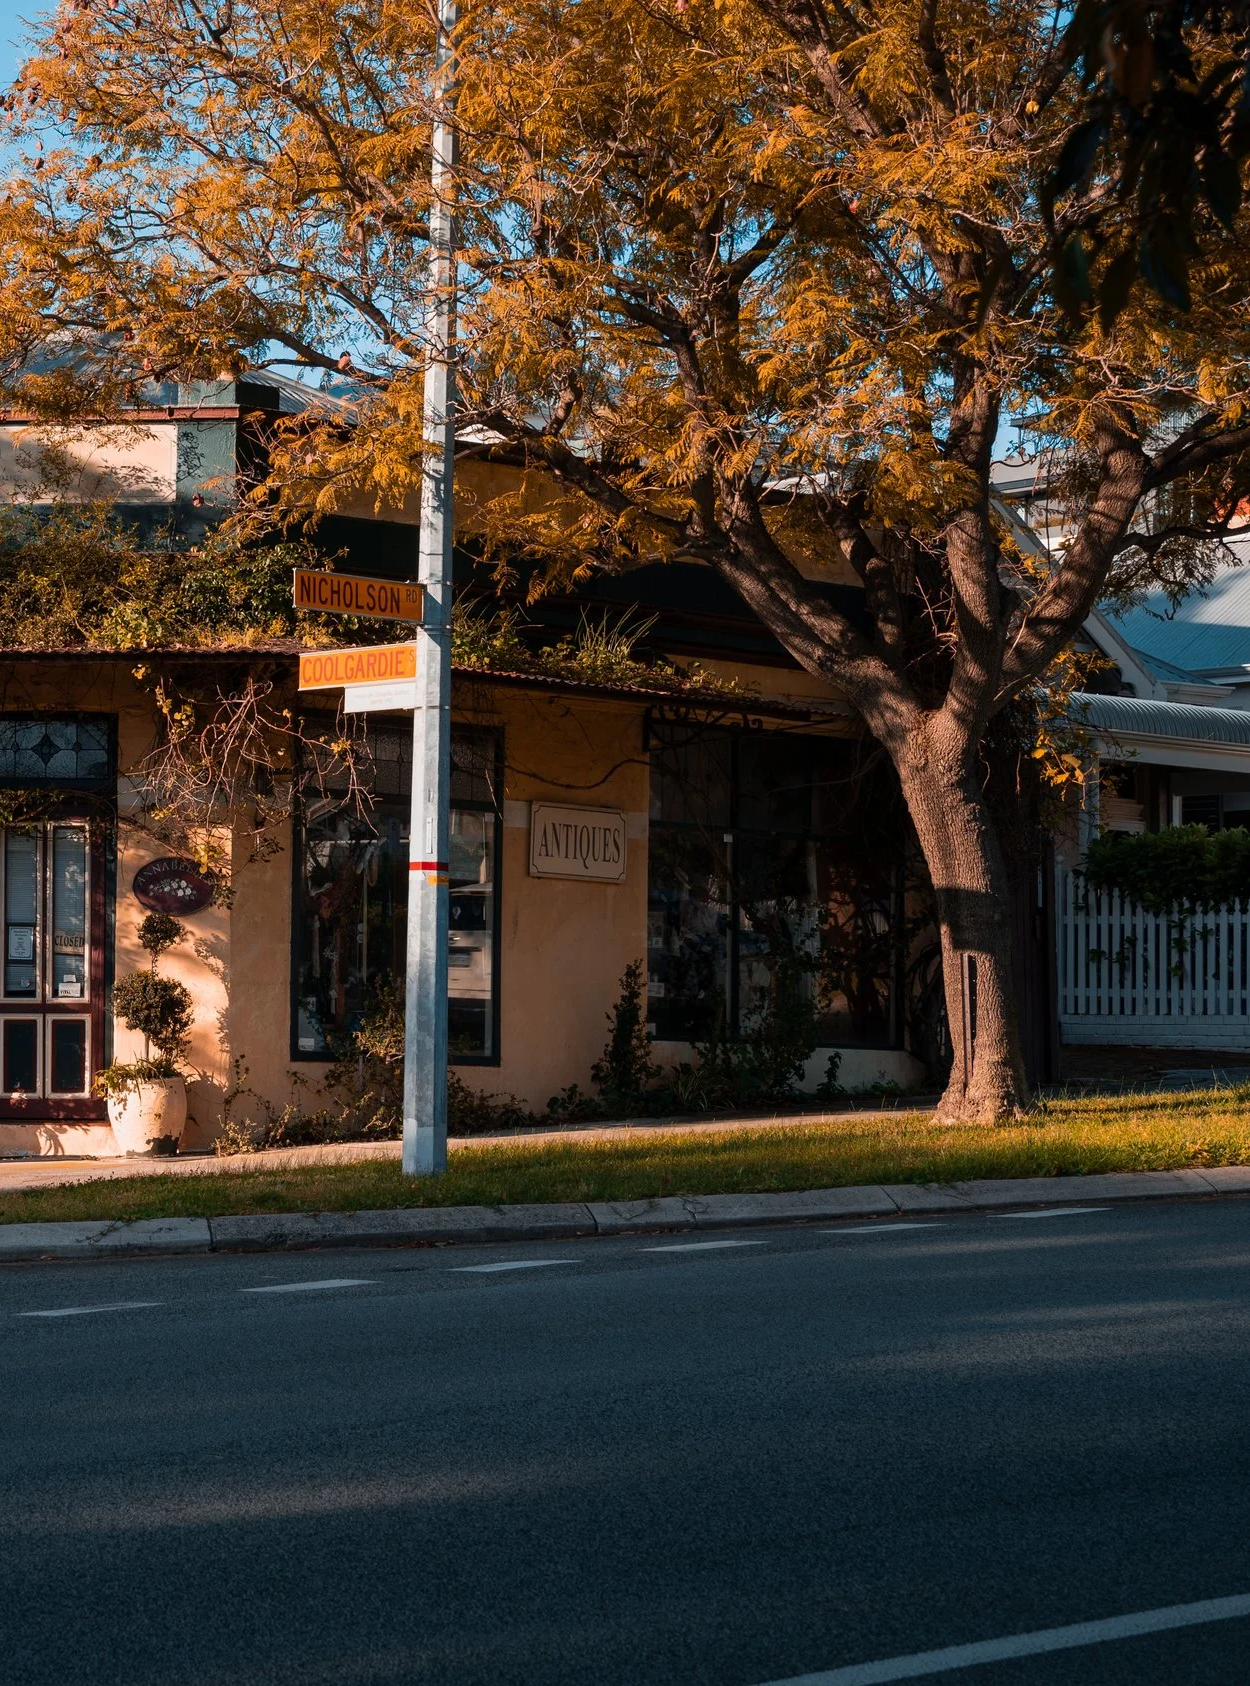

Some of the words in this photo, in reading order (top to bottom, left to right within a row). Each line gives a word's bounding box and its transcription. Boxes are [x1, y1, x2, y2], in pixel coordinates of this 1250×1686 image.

[300, 575, 400, 615] NICHOLSON
[406, 589, 418, 604] RD
[302, 650, 405, 684] COOLGARDIE
[538, 821, 621, 869] ANTIQUES
[54, 935, 84, 948] CLOSED
